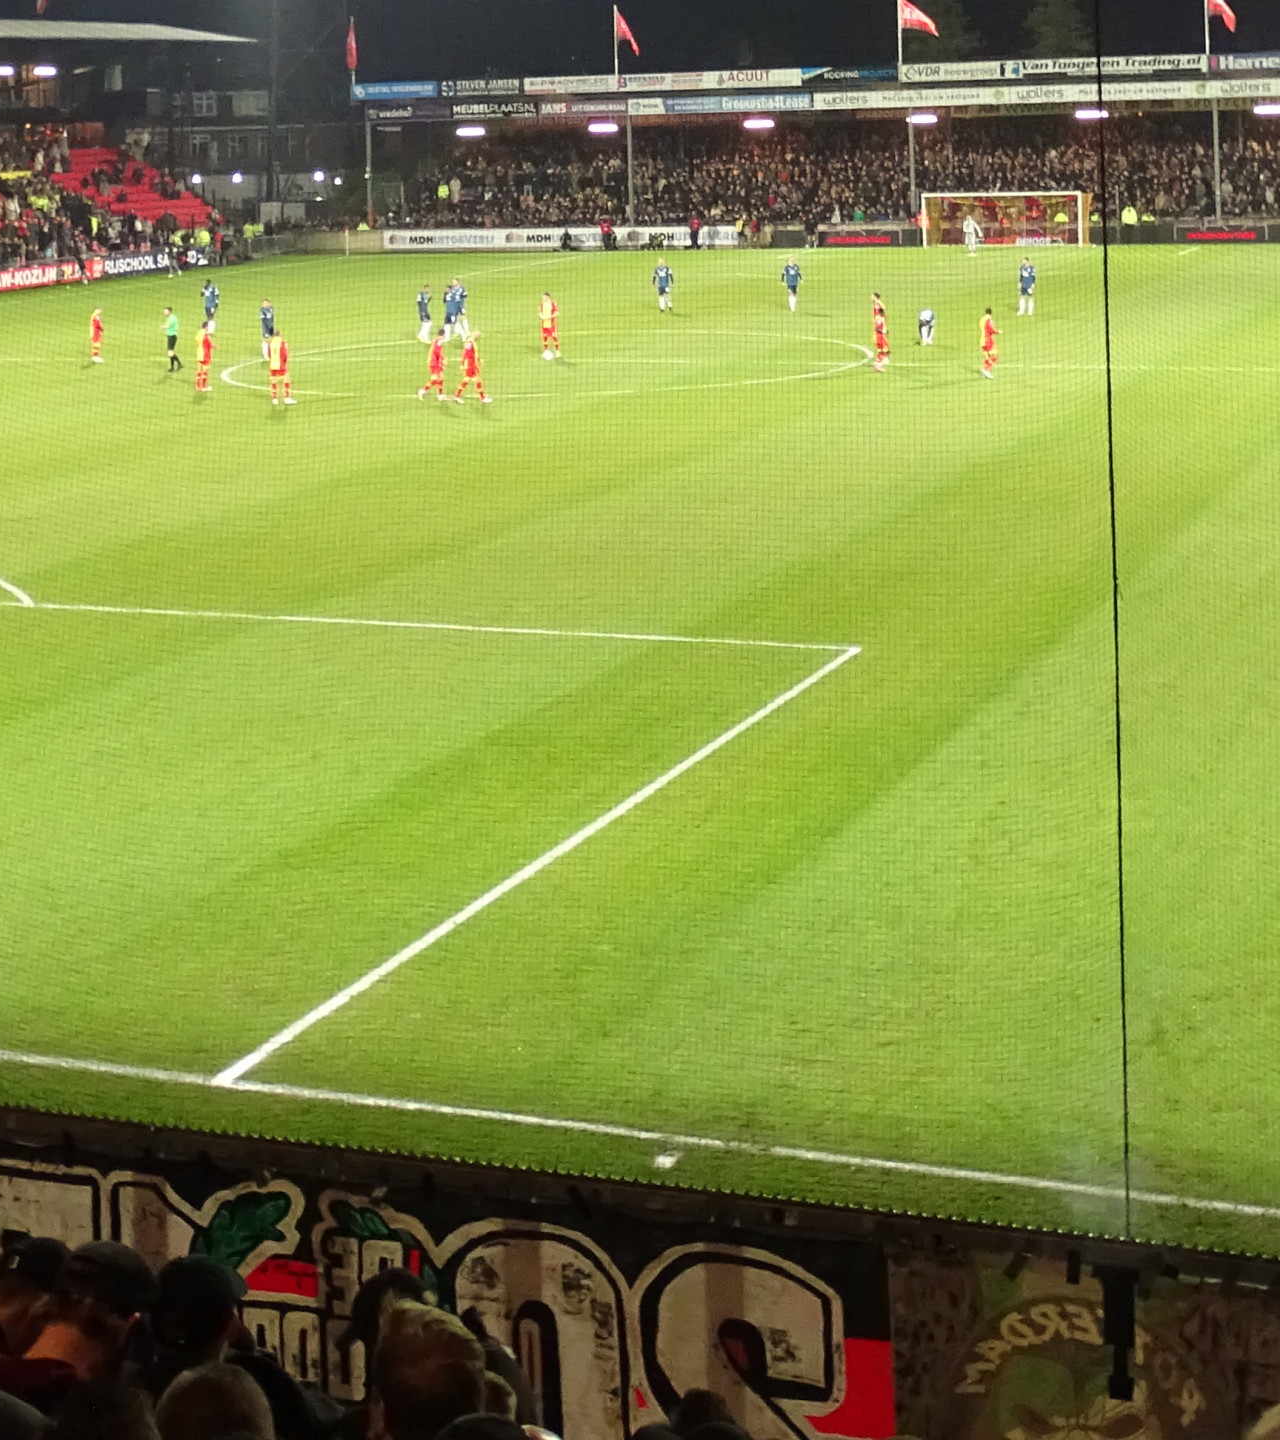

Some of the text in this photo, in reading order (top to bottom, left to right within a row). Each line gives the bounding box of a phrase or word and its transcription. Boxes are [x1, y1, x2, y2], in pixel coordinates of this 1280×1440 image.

[916, 66, 941, 77] VDR
[1021, 60, 1049, 71] Van
[727, 70, 771, 82] ACUUT
[456, 80, 485, 90] STEVEN
[486, 78, 519, 89] JANSEN
[541, 102, 568, 114] JANS
[104, 254, 156, 274] RIJSCHOOL
